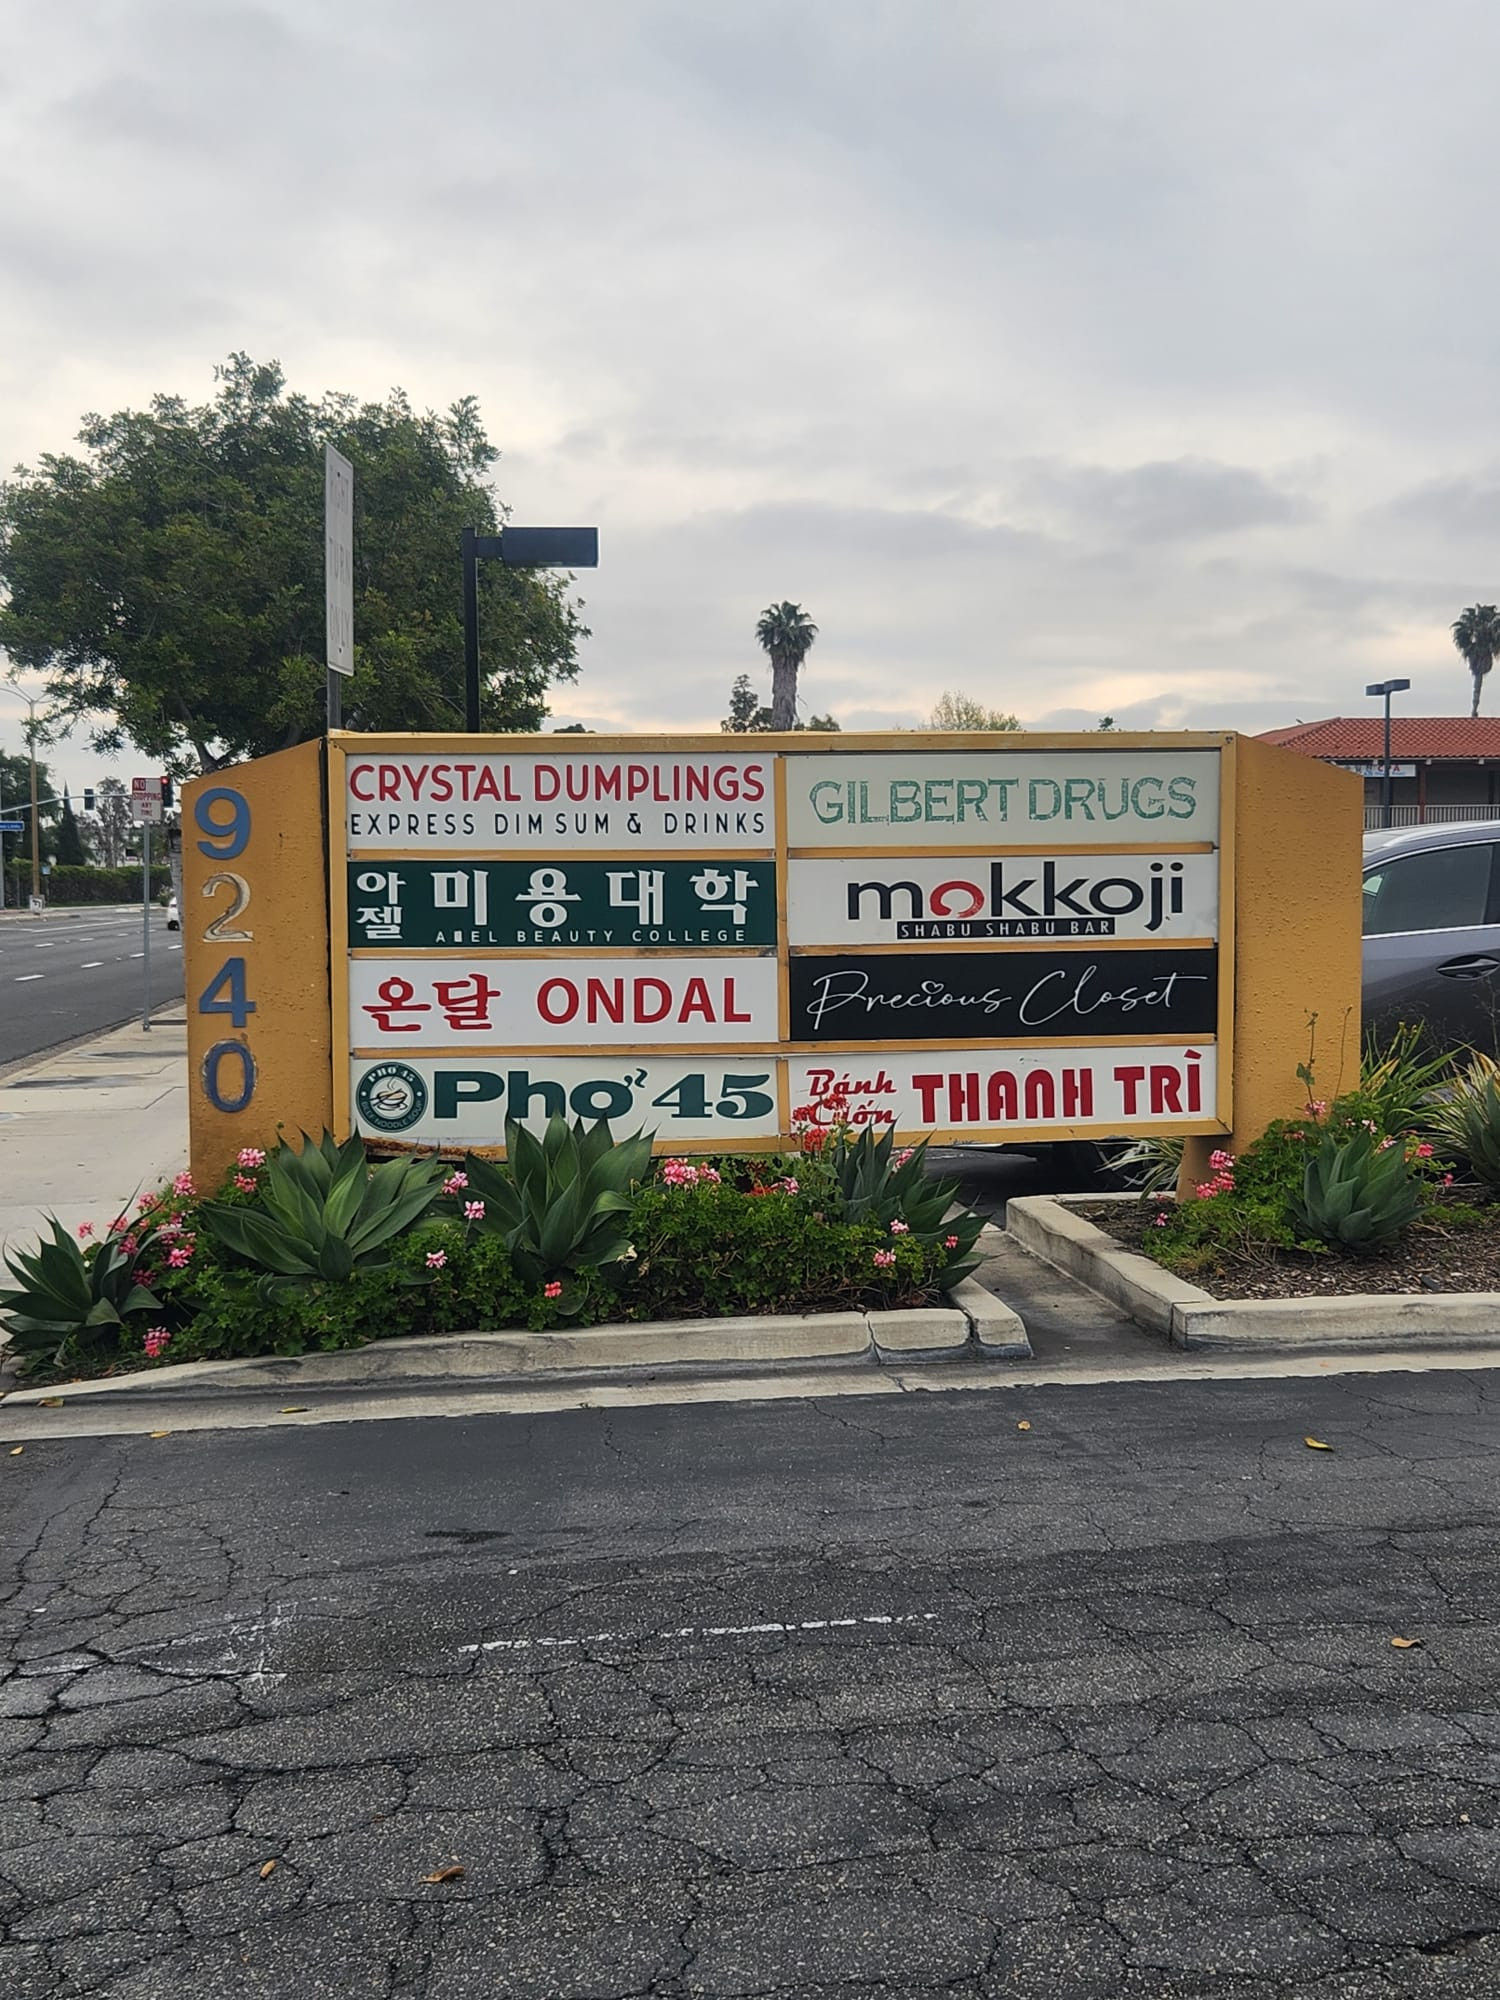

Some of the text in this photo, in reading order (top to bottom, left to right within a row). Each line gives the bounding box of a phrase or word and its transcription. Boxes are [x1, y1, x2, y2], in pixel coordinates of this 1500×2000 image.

[134, 779, 145, 790] NO
[350, 764, 765, 802] CRYSTAL DUMPLINGS
[1377, 764, 1401, 772] CA
[809, 776, 1198, 825] GILBERT DRUGS
[351, 812, 766, 836] EXPRESS DIM SUM & DRINKS
[847, 861, 1184, 932] mokkoji
[194, 787, 258, 1113] 9240
[517, 930, 613, 943] BEAUTY
[632, 929, 747, 943] COLLEGE
[901, 919, 1111, 938] SHABU SHABU BAR
[361, 974, 501, 1032] 온달
[536, 977, 752, 1024] ONDAL
[806, 965, 1209, 1031] Precious Closet
[652, 1073, 774, 1119] 45
[806, 1069, 897, 1096] Bánh
[911, 1048, 1203, 1124] THANH TRÌ
